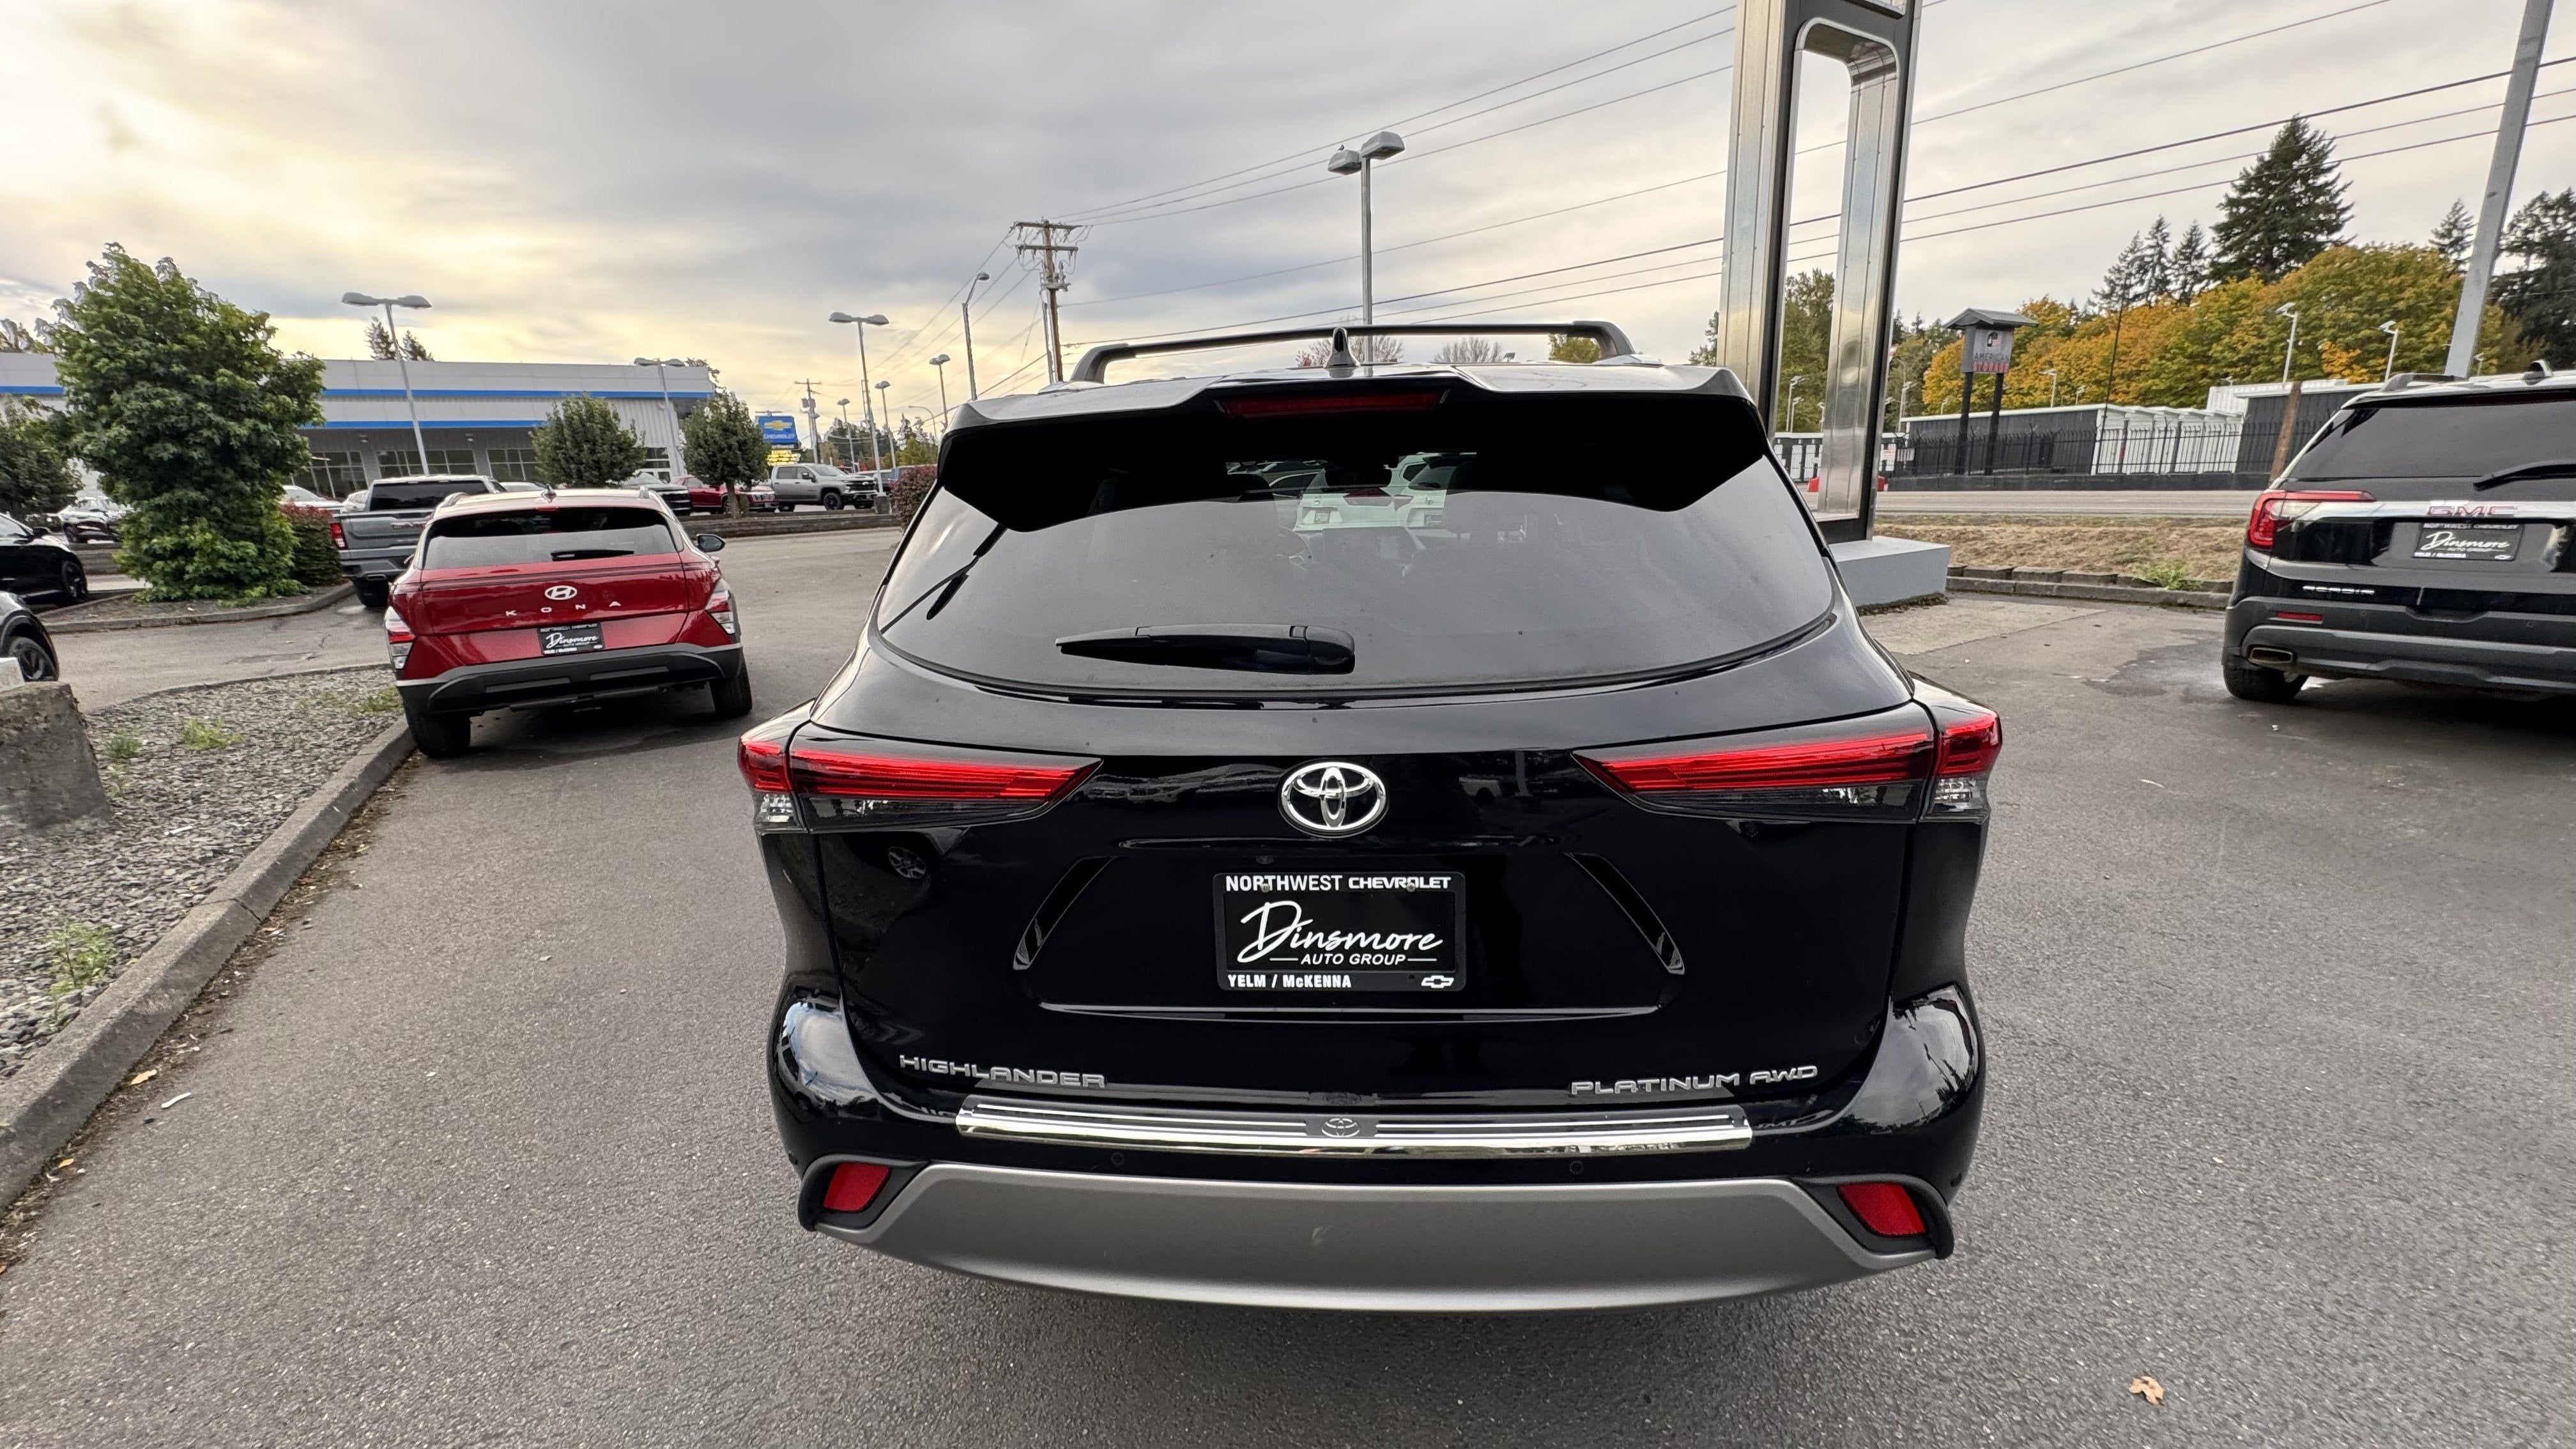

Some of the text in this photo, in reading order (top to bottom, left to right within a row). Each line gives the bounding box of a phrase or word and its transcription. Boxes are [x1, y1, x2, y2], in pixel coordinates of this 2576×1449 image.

[2428, 506, 2517, 516] GMC
[1226, 875, 1451, 892] NORTHWEST CHEVROLET
[1238, 900, 1443, 963] Dinsmore
[1301, 953, 1406, 965] AUTO GROUP
[1228, 974, 1266, 988] YELM
[1283, 974, 1352, 988] McKENNA
[900, 1054, 1105, 1088] HIGHLANDER
[1571, 1065, 1818, 1096] PLATINUM AWD
